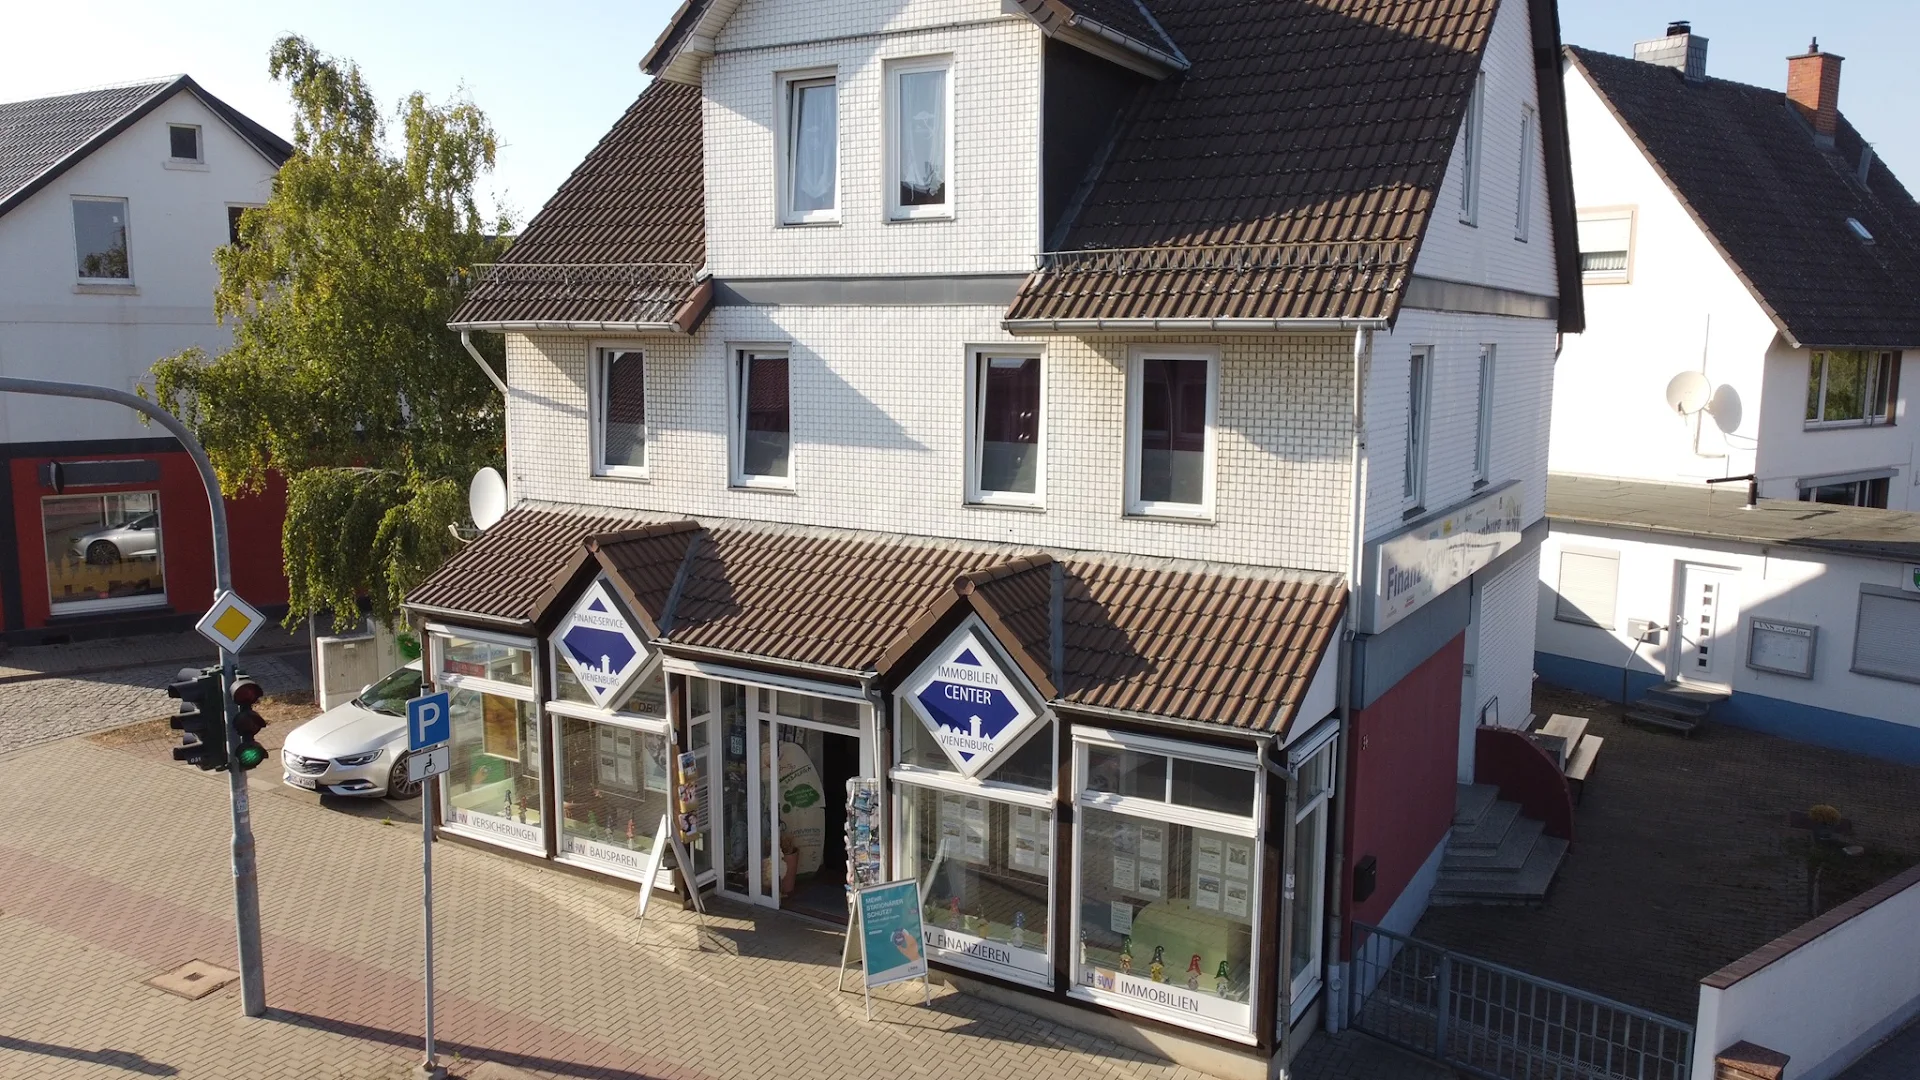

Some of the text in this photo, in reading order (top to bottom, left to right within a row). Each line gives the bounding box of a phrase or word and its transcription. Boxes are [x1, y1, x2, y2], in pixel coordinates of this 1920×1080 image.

[574, 612, 624, 629] FINANZ-SERVICE
[580, 672, 620, 687] VIENENBURG
[938, 665, 998, 685] IMMOBILIEN
[944, 684, 992, 705] CENTER
[418, 702, 440, 743] P
[941, 734, 994, 753] VIENENBURG
[471, 816, 537, 841] VERSICHERUNGEN
[589, 846, 638, 867] BAUSPAREN
[937, 934, 1010, 964] FINANZIEREN
[1121, 980, 1199, 1012] IMMOBILIEN
